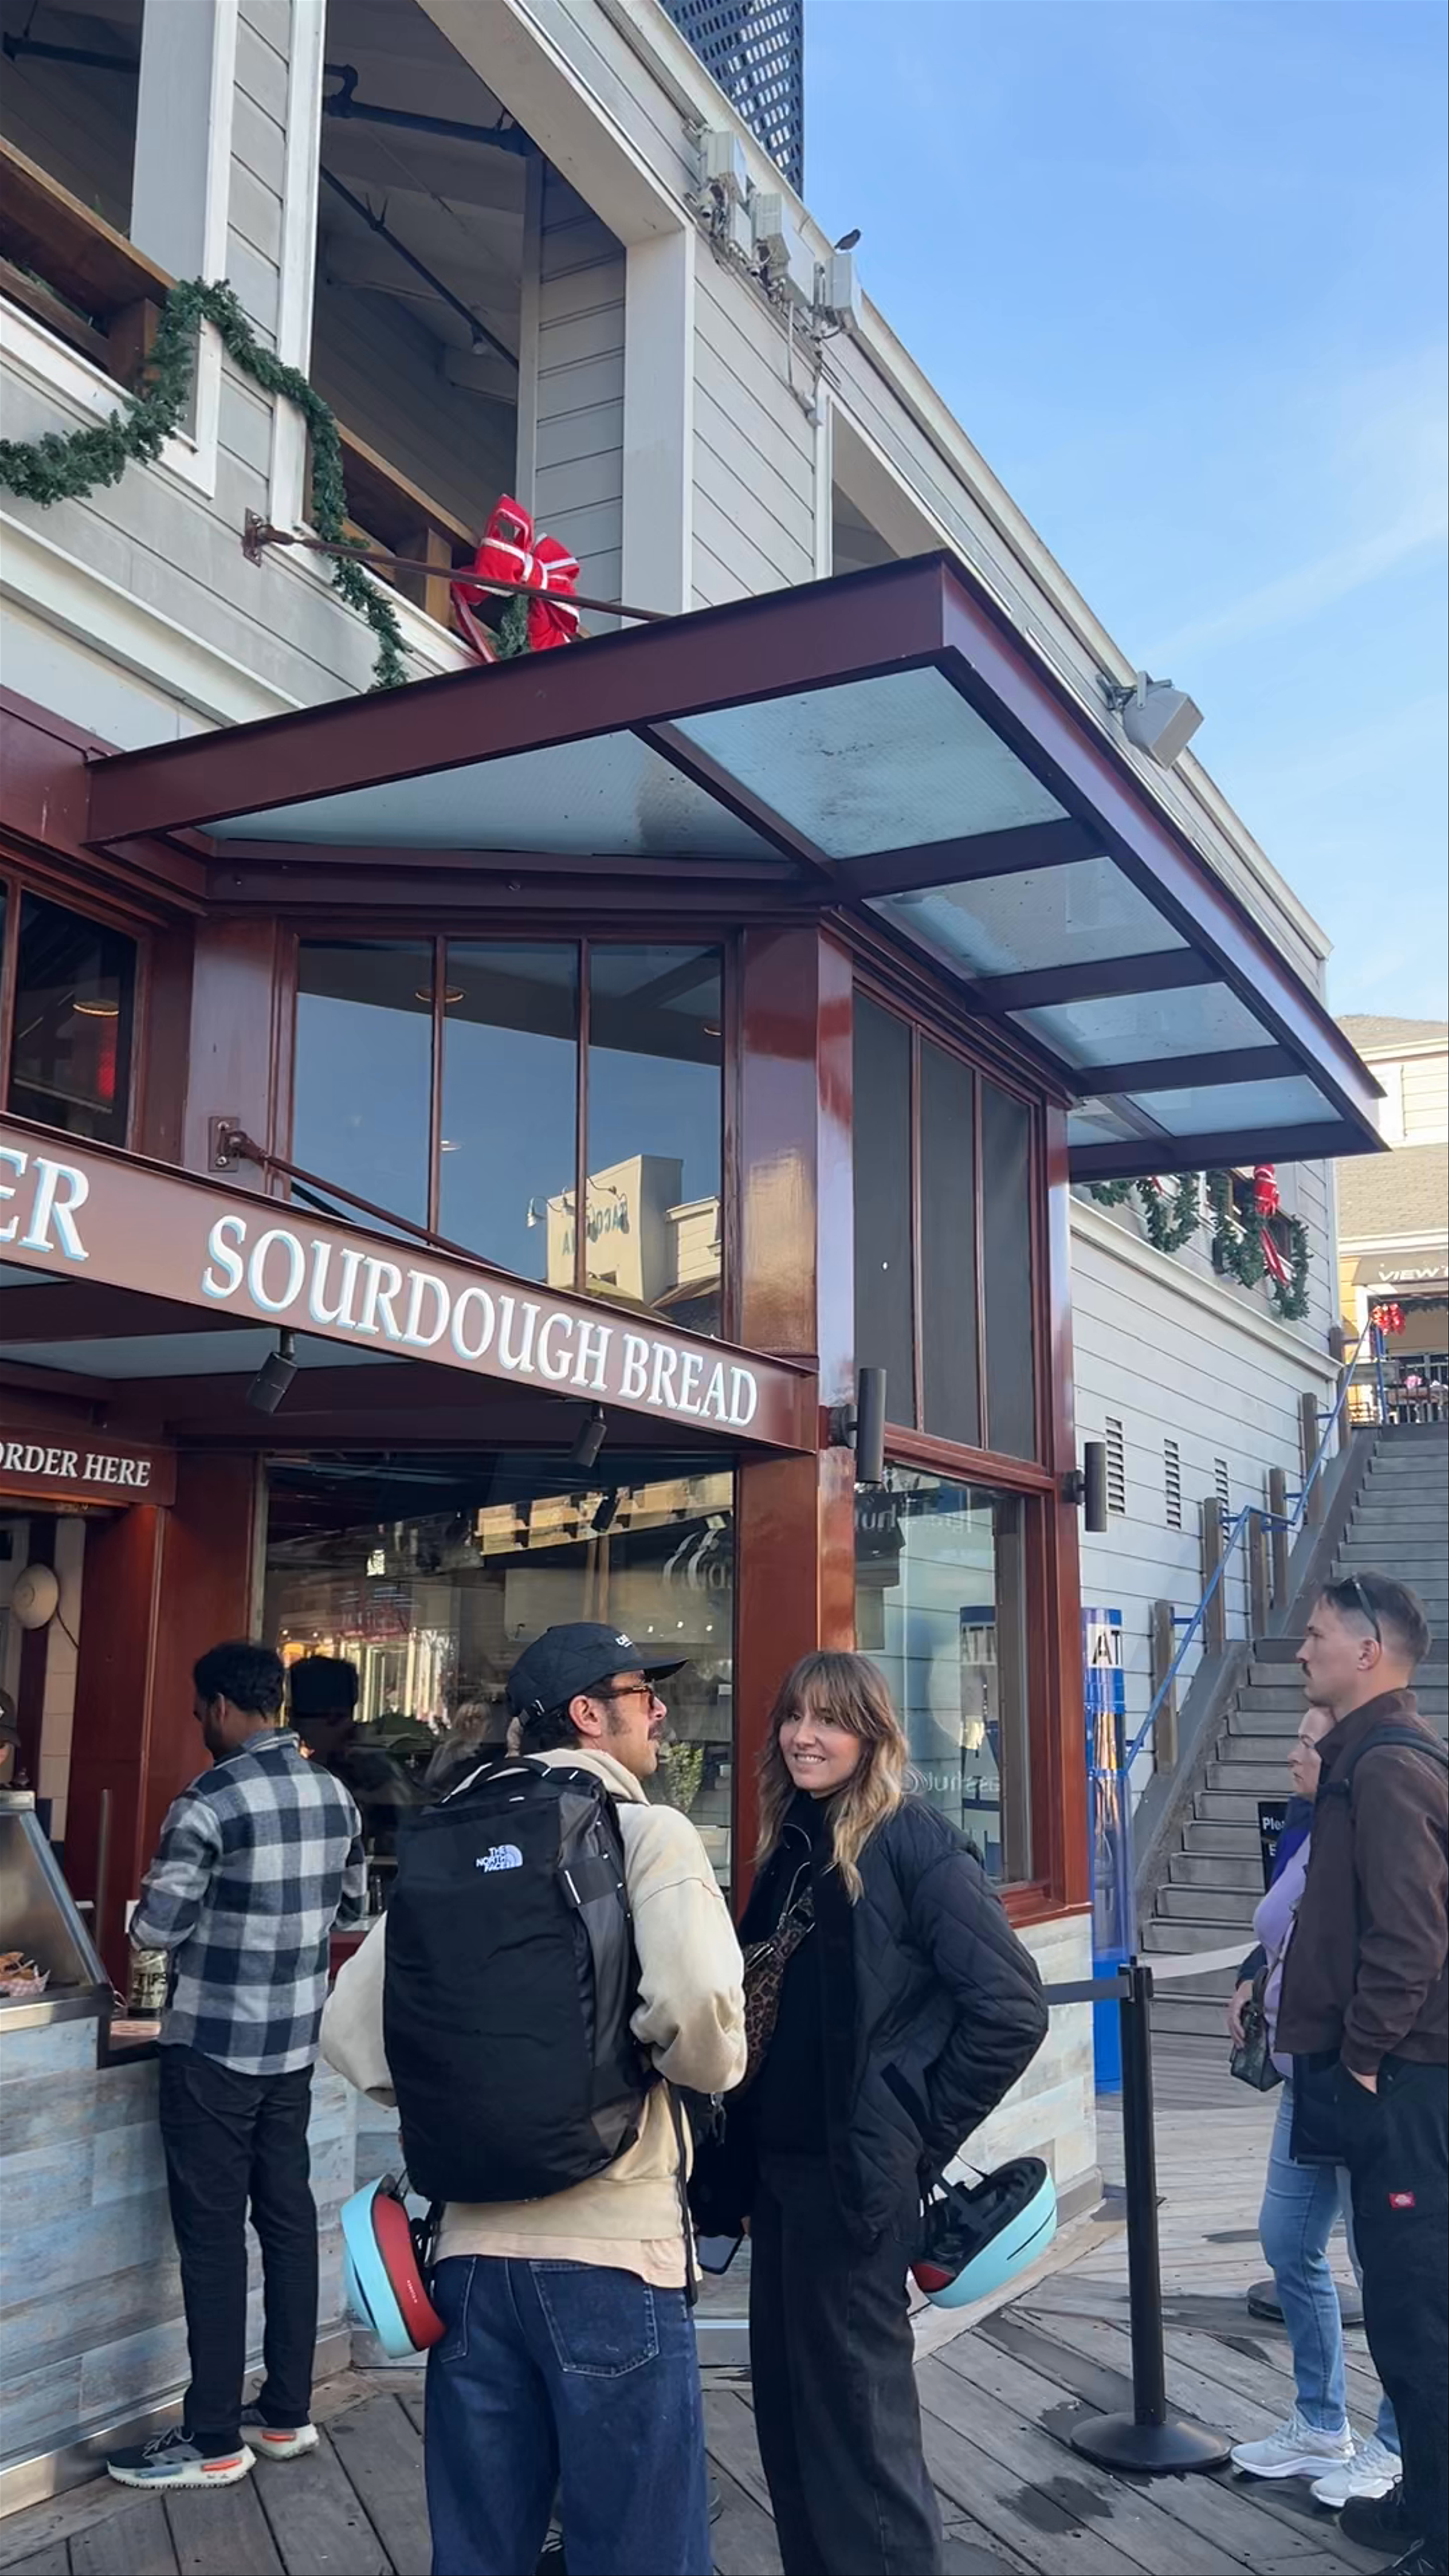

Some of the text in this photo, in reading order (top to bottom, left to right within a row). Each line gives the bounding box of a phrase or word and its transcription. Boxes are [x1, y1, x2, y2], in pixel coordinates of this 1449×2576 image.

[1378, 1268, 1439, 1281] VIEW
[201, 1215, 613, 1392] SOURDOUGH
[618, 1333, 758, 1427] BREAD
[82, 1453, 151, 1487] HERE
[1262, 1817, 1285, 1830] Ple
